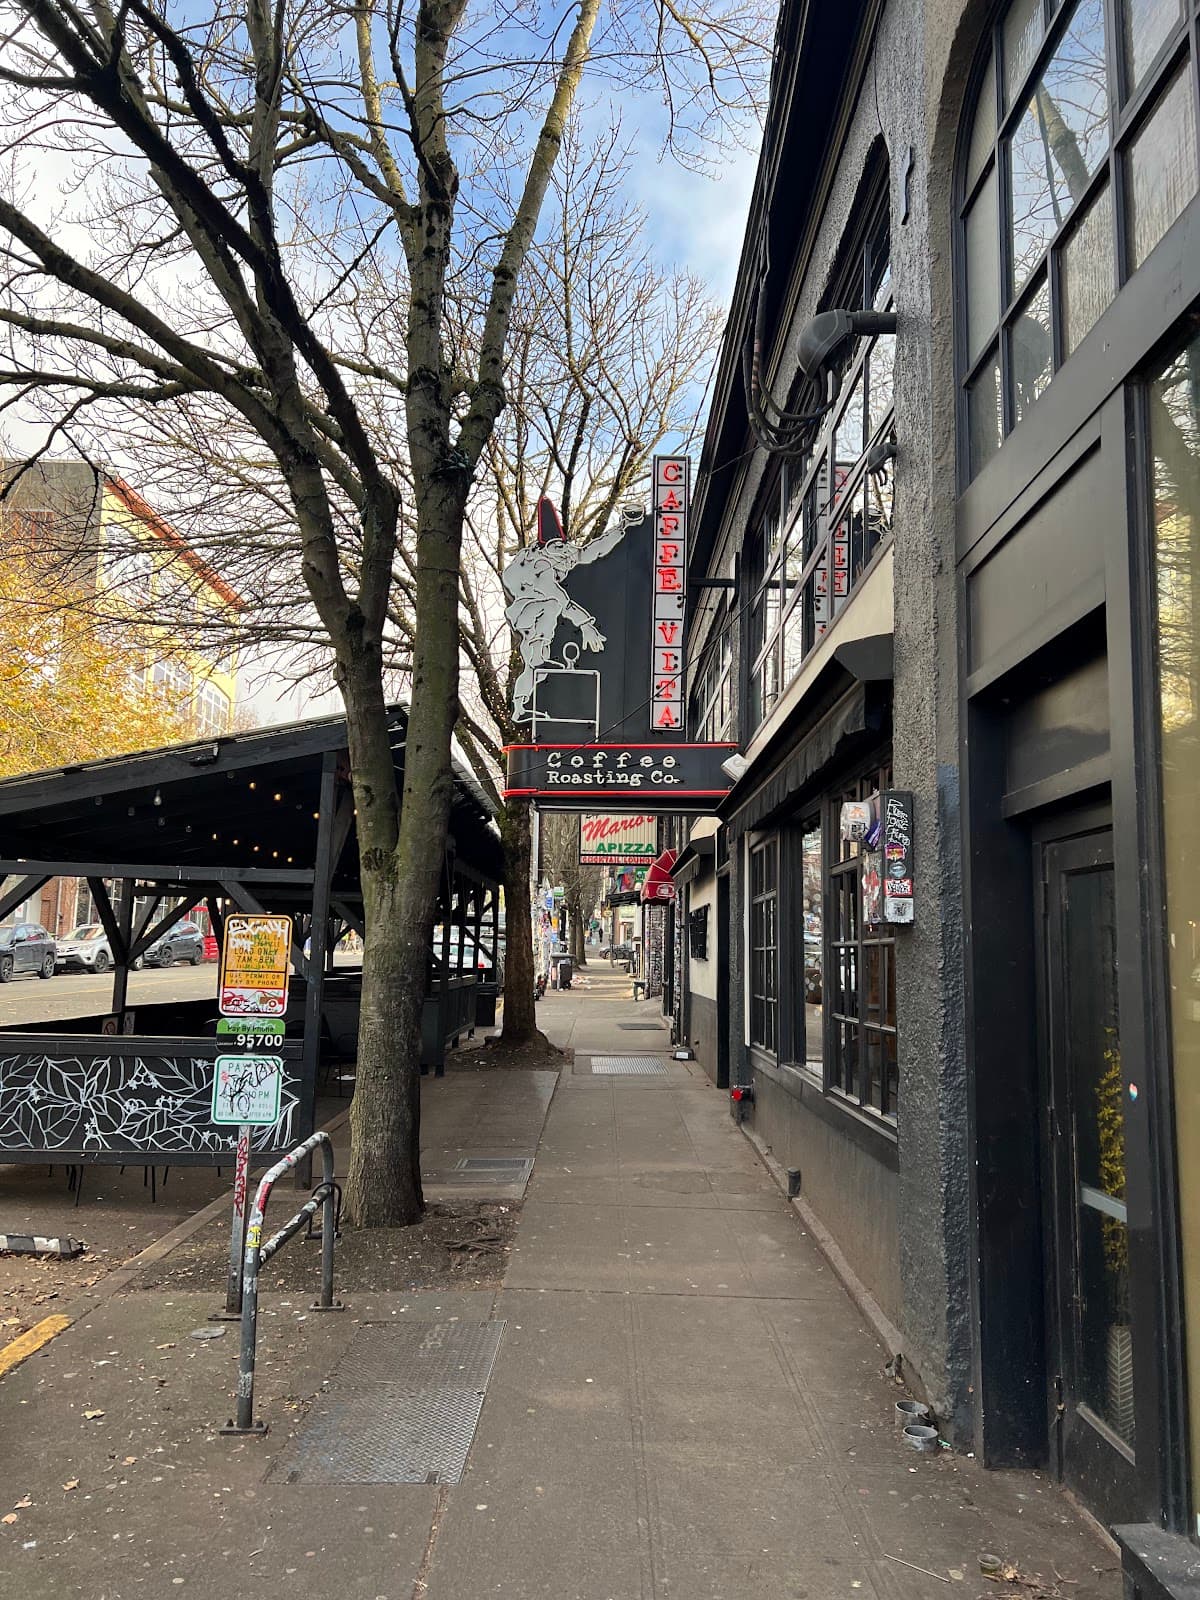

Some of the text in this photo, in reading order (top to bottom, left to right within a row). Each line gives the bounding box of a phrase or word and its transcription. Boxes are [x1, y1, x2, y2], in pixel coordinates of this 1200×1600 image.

[657, 463, 681, 725] CAFFE VITA
[547, 751, 676, 768] Coffee
[546, 769, 681, 787] Roasting Co.
[596, 842, 656, 853] APIZZA
[581, 855, 620, 864] COCKTAIL
[236, 1034, 283, 1047] 95700
